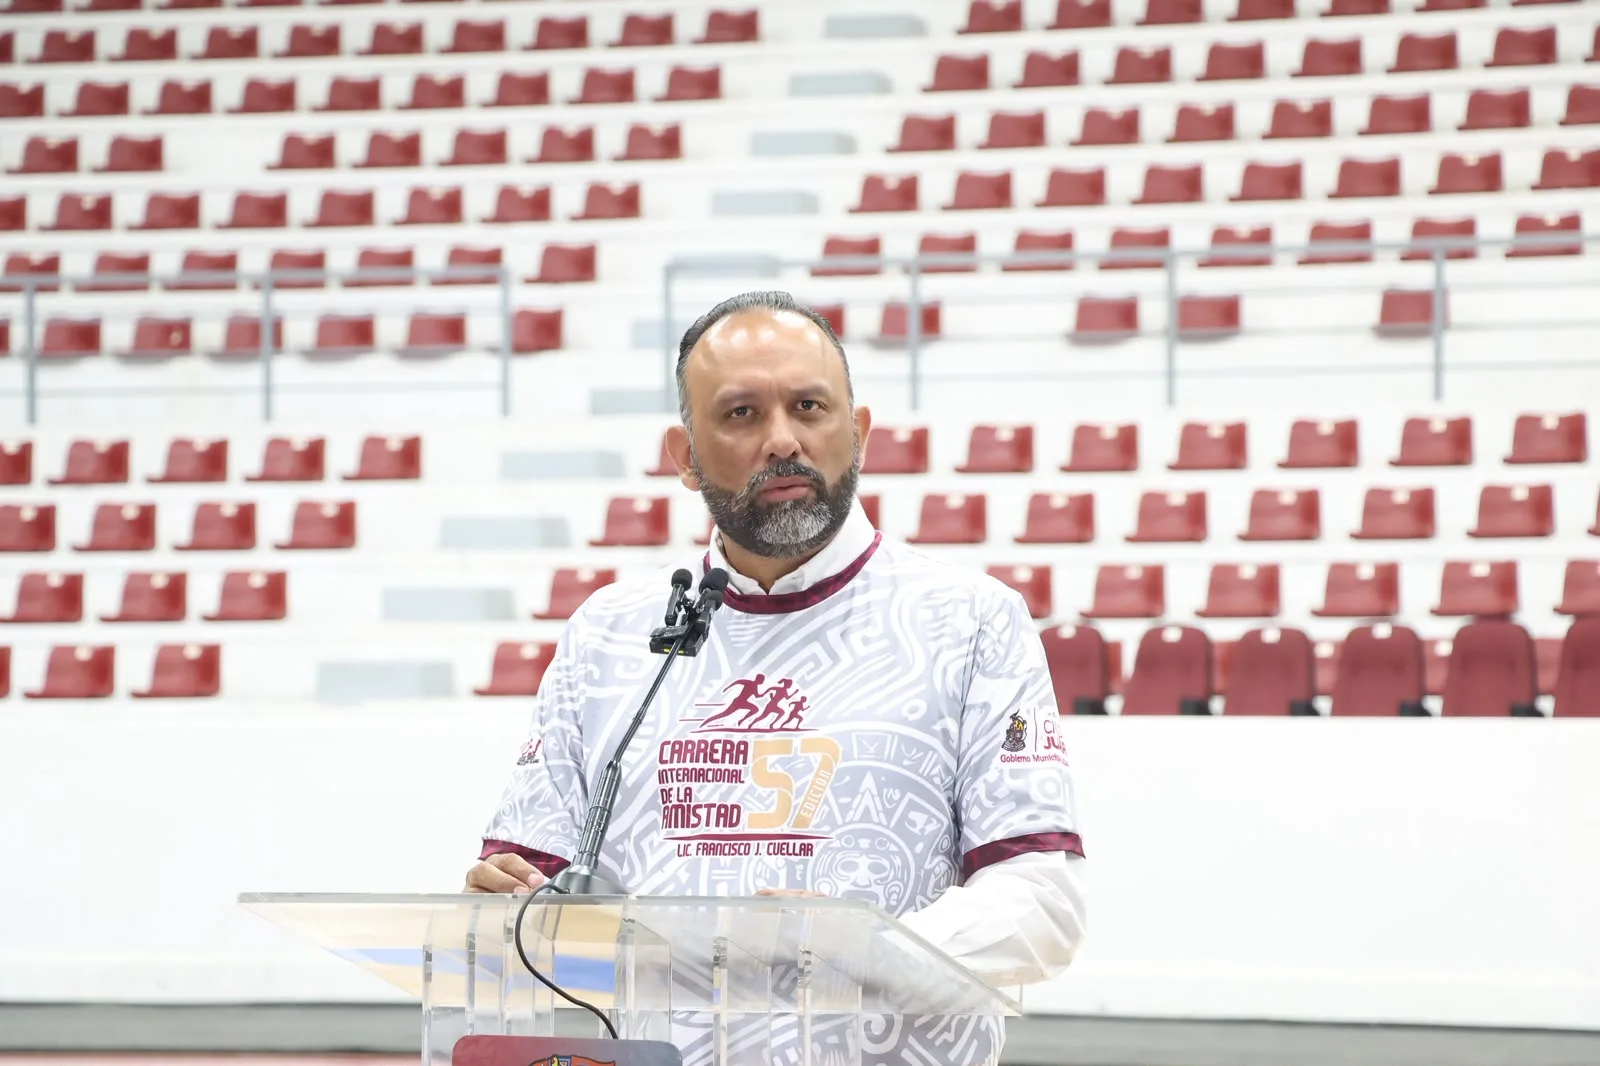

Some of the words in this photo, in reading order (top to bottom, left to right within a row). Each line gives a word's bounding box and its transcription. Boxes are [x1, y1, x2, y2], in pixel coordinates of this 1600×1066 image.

[658, 739, 749, 765] CARRERA
[1000, 754, 1031, 763] Gobierno
[658, 768, 745, 784] INTERNACIONAL
[747, 737, 840, 829] 57
[660, 787, 673, 804] DE
[676, 786, 693, 803] LA
[661, 803, 742, 830] AMISTAD
[677, 843, 692, 858] LIC.
[695, 842, 751, 856] FRANCISCO
[754, 842, 762, 856] J.
[766, 842, 814, 857] CUELLAR
